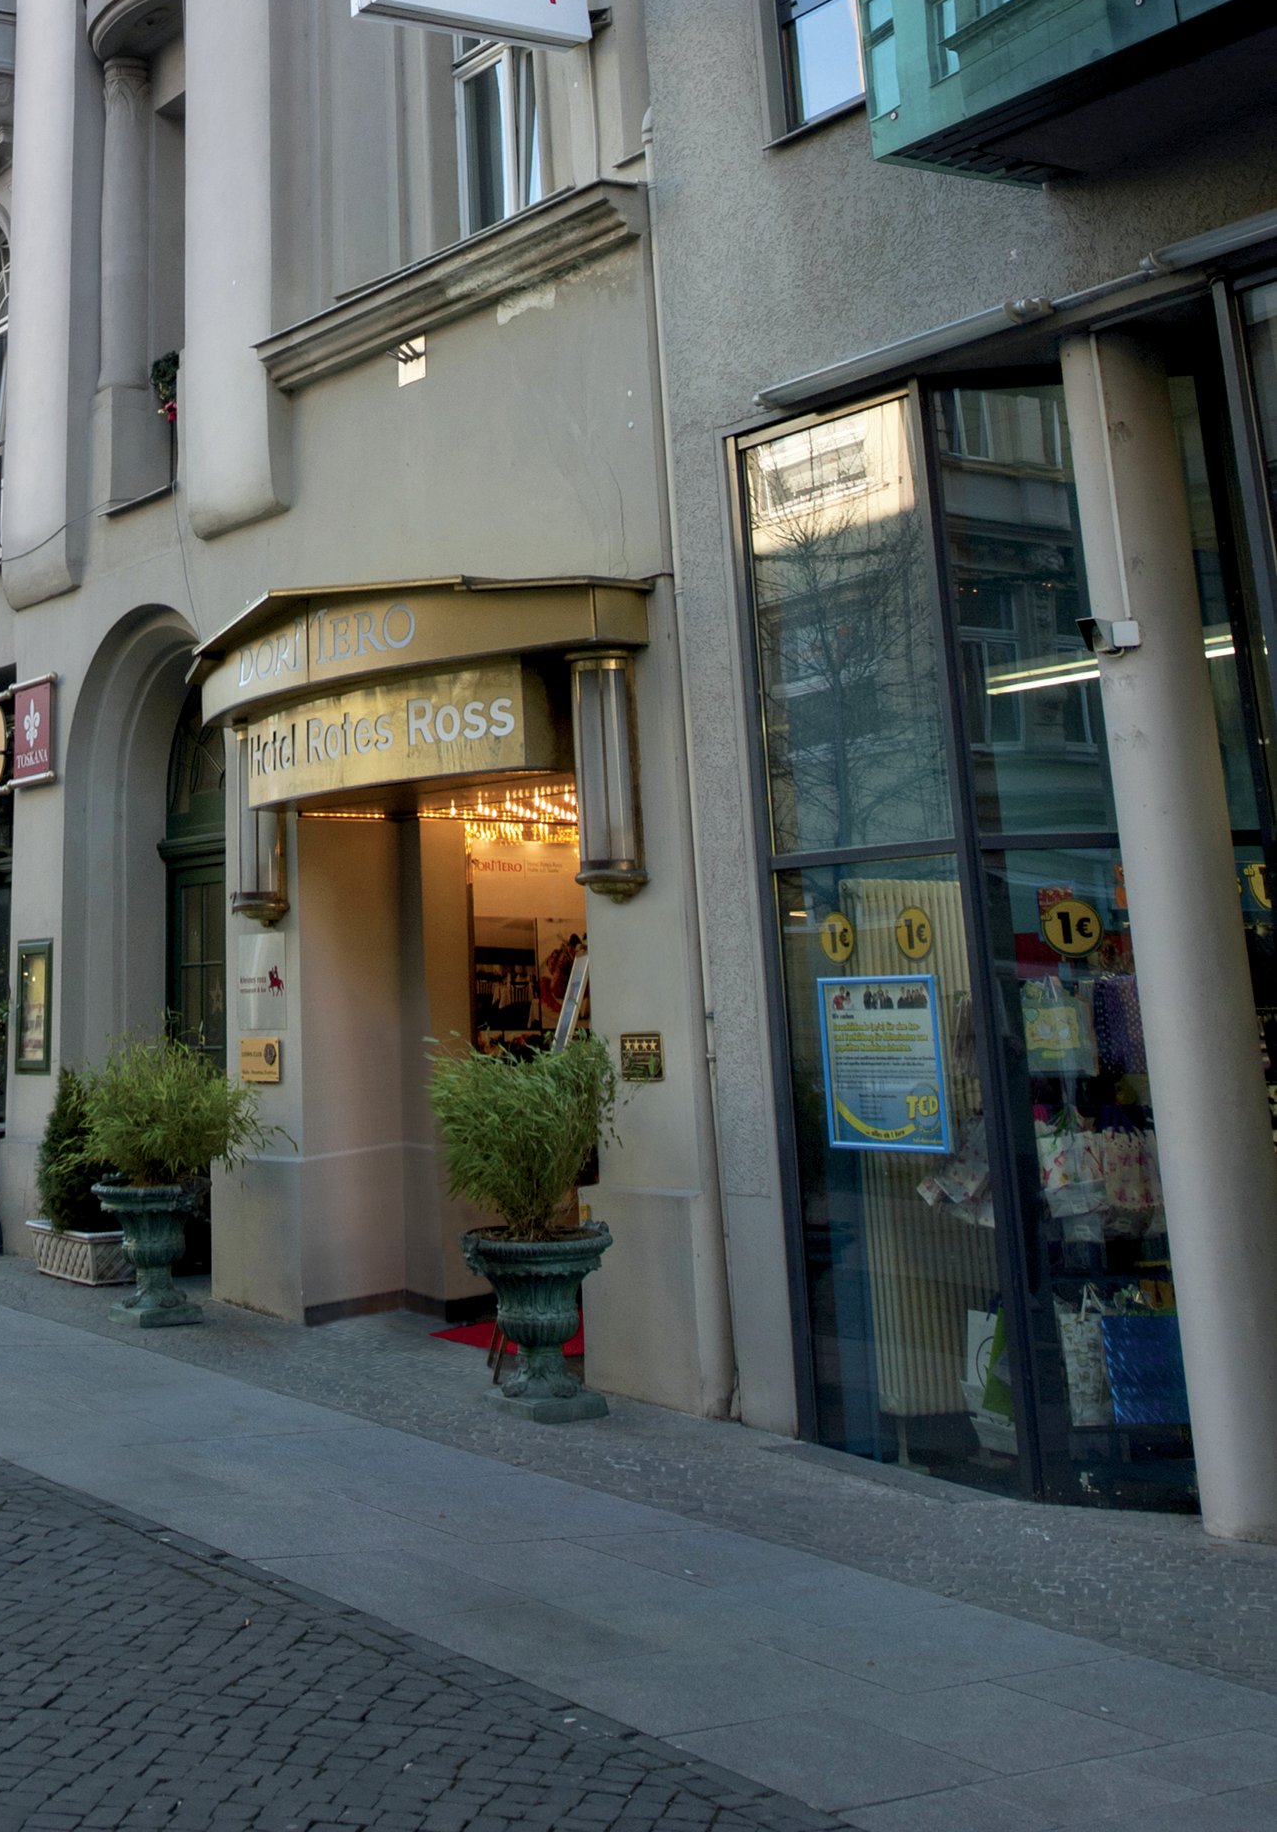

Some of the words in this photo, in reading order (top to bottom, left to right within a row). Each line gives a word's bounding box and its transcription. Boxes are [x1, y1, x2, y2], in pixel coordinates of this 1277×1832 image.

[238, 602, 416, 687] DORMERO
[17, 749, 48, 768] TOSKANA
[250, 723, 298, 779] Hotel
[306, 712, 395, 763] Rotes
[407, 698, 515, 745] Ross
